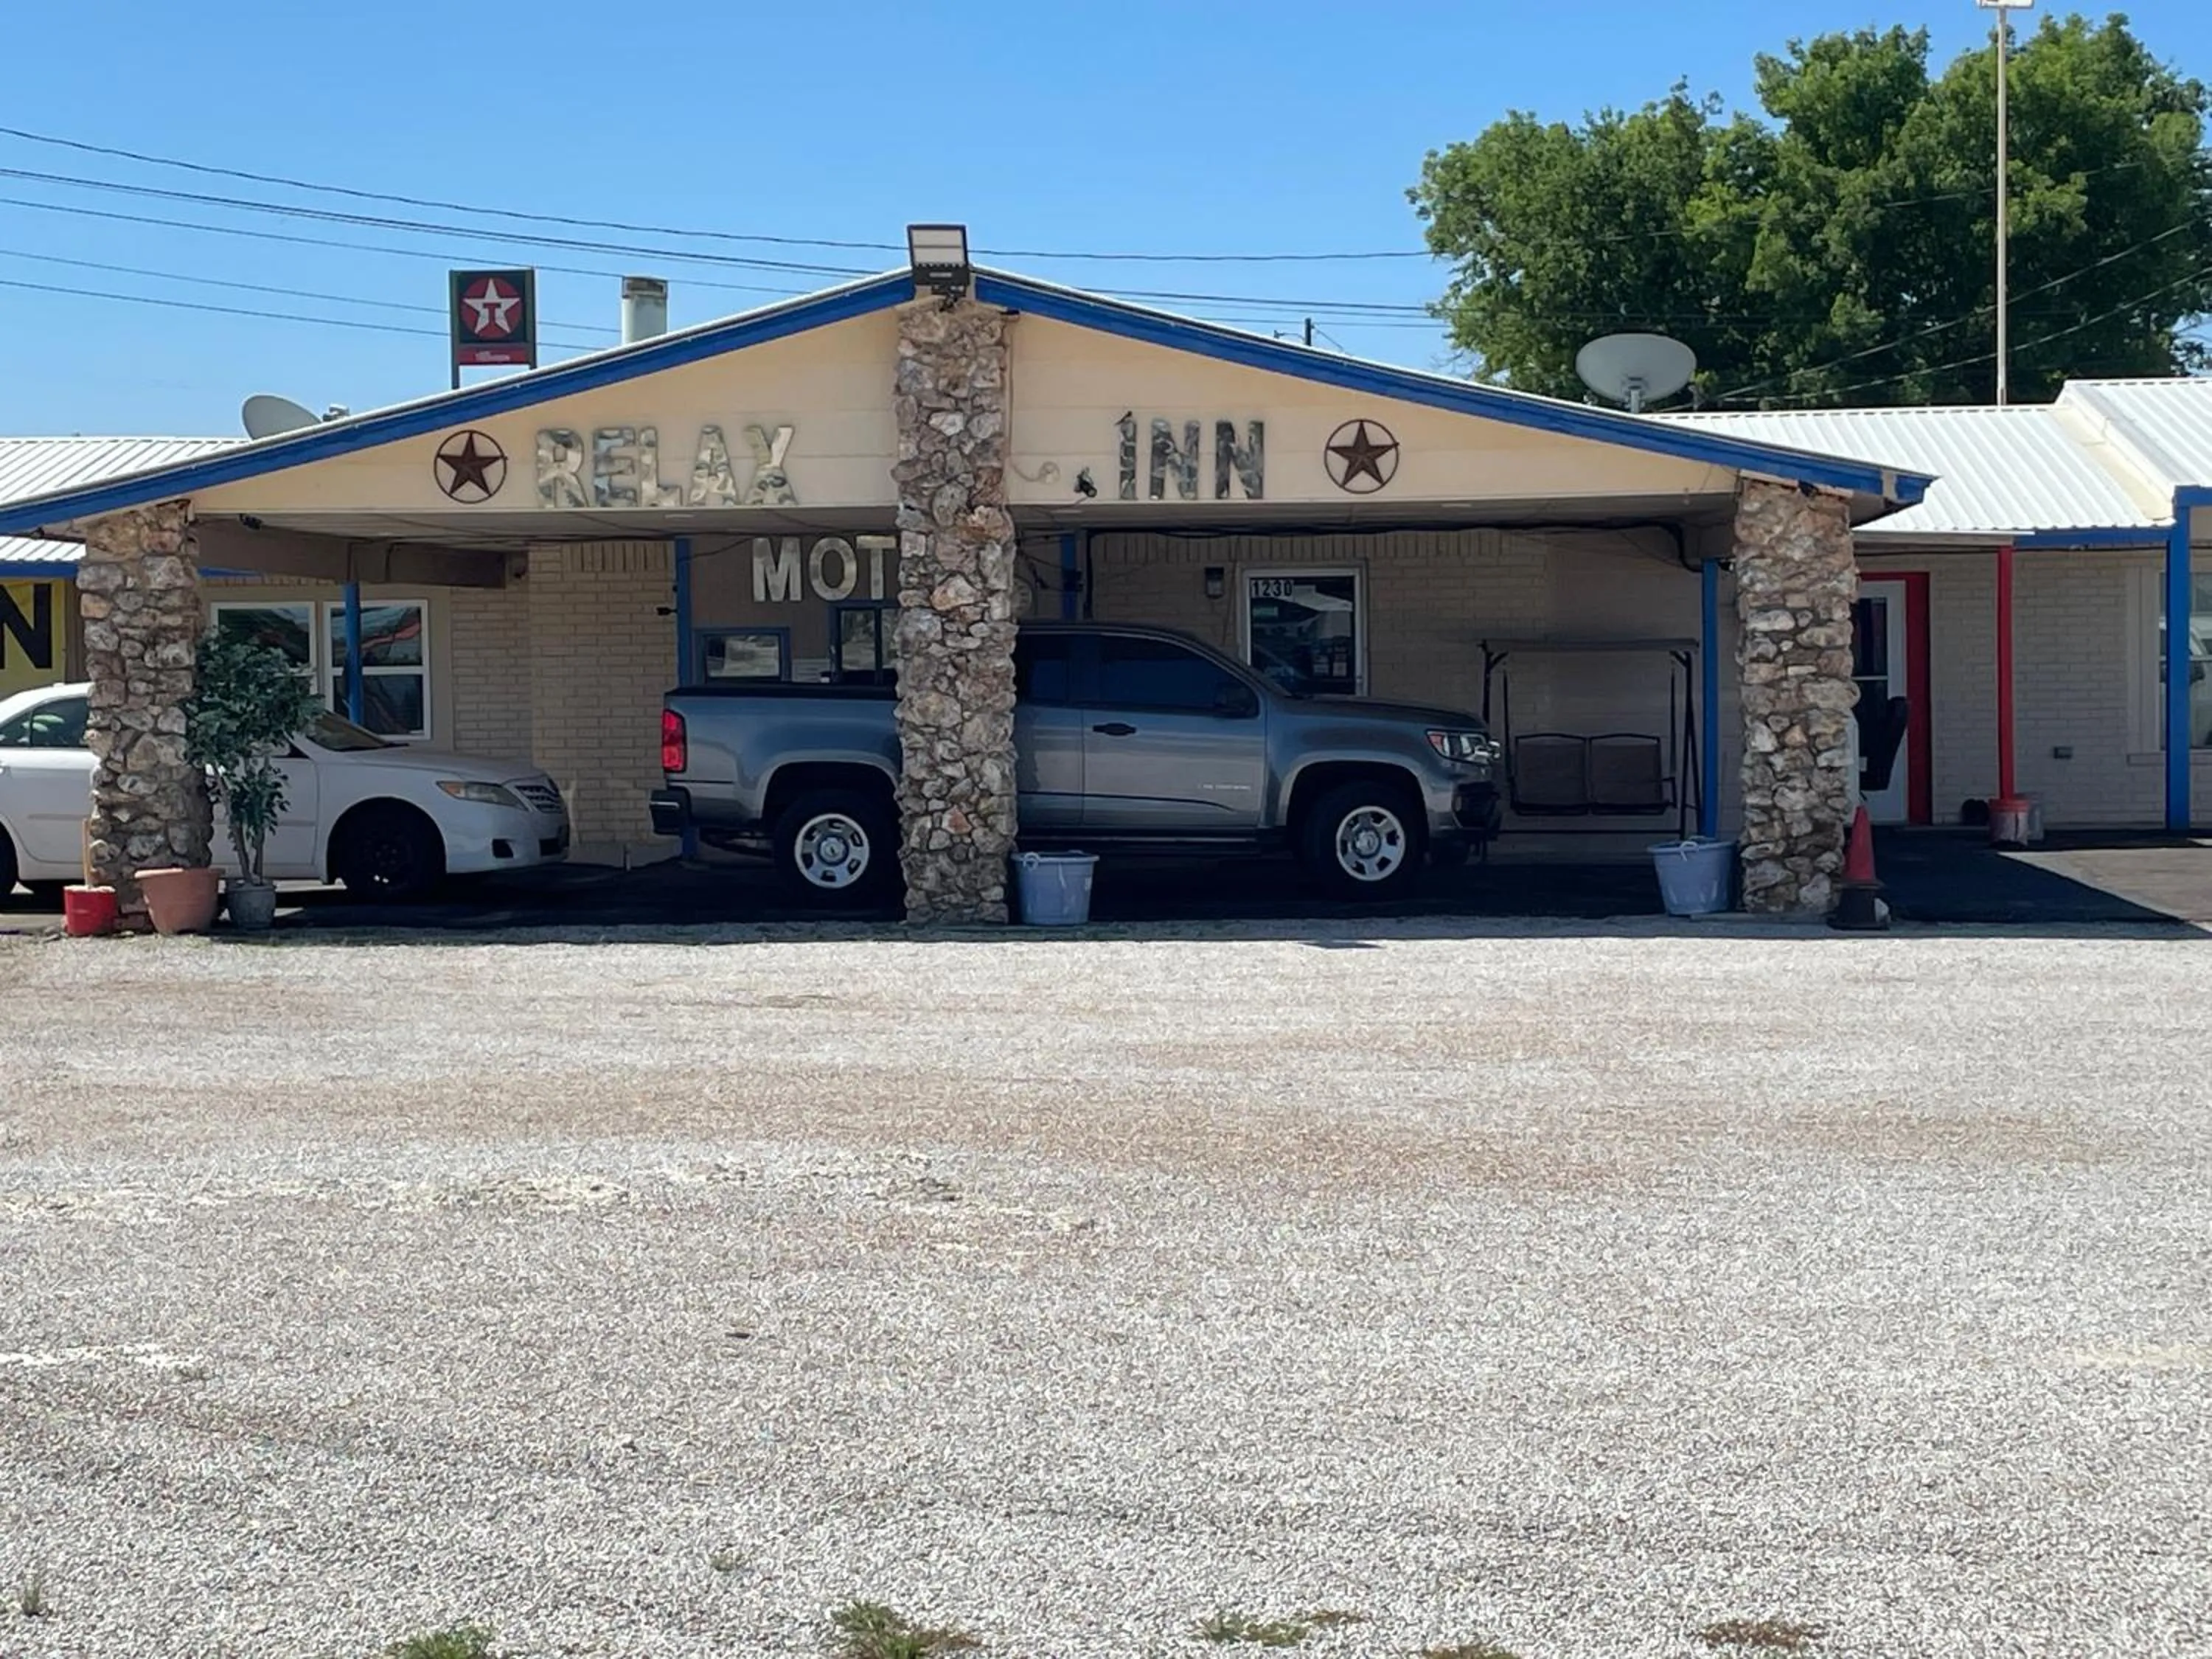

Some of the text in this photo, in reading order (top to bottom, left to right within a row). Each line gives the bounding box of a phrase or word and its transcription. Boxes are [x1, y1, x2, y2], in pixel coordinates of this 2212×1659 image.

[535, 418, 1265, 508] RELAX INN
[1252, 580, 1293, 597] 1230
